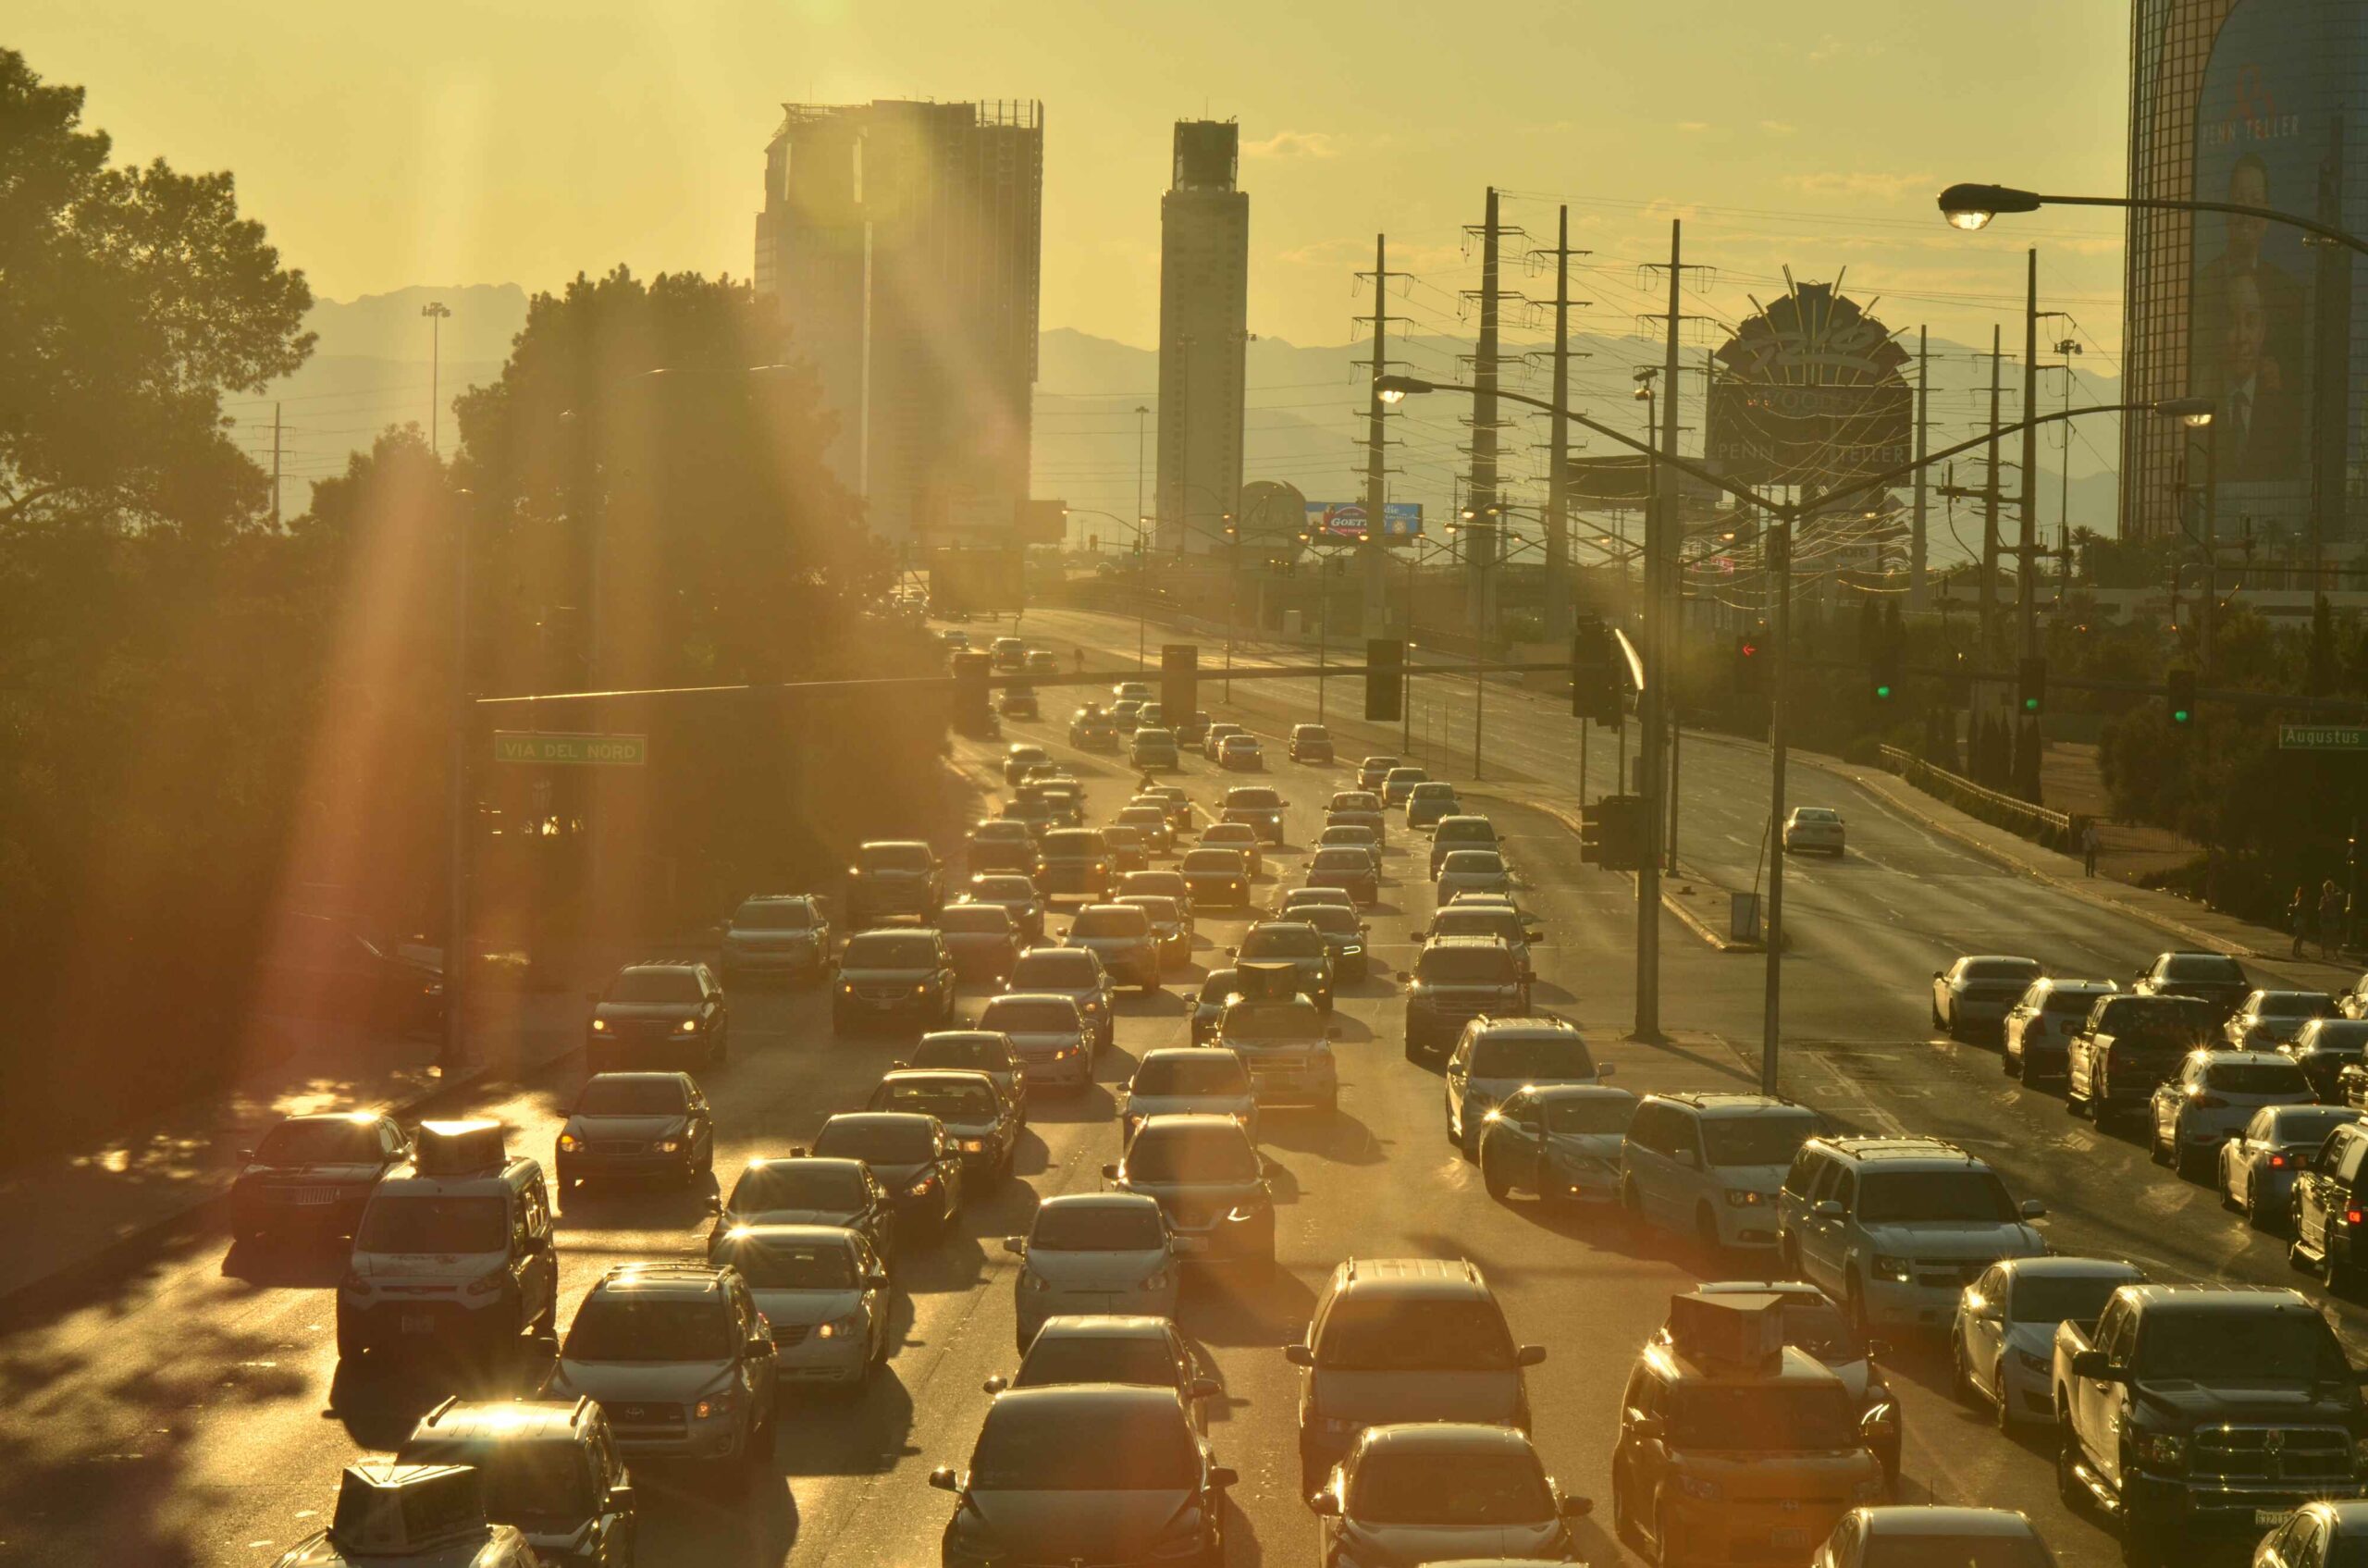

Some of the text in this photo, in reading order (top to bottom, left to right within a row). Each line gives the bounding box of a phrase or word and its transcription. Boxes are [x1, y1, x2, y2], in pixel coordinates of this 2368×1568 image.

[2202, 121, 2237, 145] PENN
[2246, 115, 2300, 141] TELLER
[1718, 443, 1905, 463] PENN TELLER
[1330, 517, 1368, 526] GOETT
[2286, 728, 2360, 746] Augustus
[503, 743, 636, 759] VIA DEL NORD
